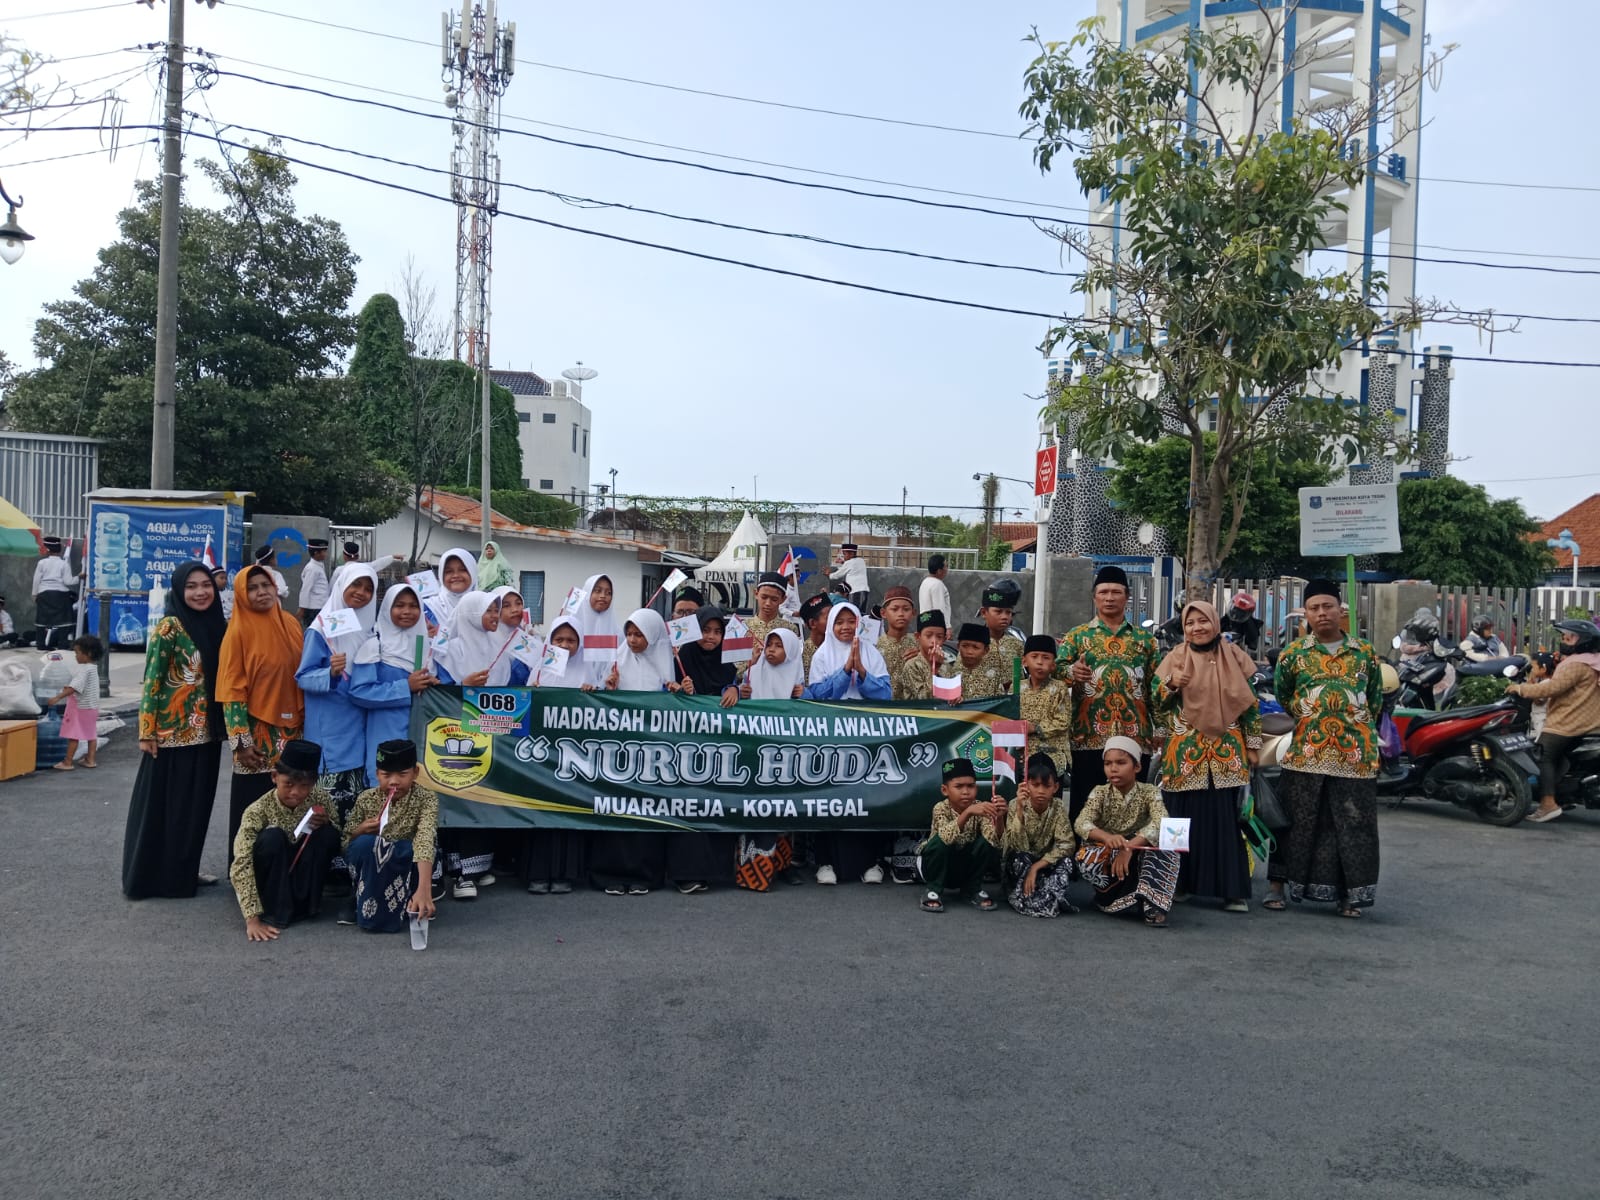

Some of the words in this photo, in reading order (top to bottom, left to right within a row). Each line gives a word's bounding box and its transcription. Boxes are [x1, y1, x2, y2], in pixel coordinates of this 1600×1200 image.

[146, 522, 178, 534] AQUA
[145, 561, 177, 574] AQUA
[704, 570, 738, 582] PDAM
[478, 692, 516, 712] 068
[543, 705, 645, 732] MADRASAH
[650, 709, 722, 734] DINIYAH
[727, 714, 833, 737] TAKMILIYAH
[834, 716, 919, 736] AWALIYAH
[593, 796, 725, 817] MUARAREJA
[743, 799, 798, 817] KOTA
[803, 798, 869, 817] TEGAL
